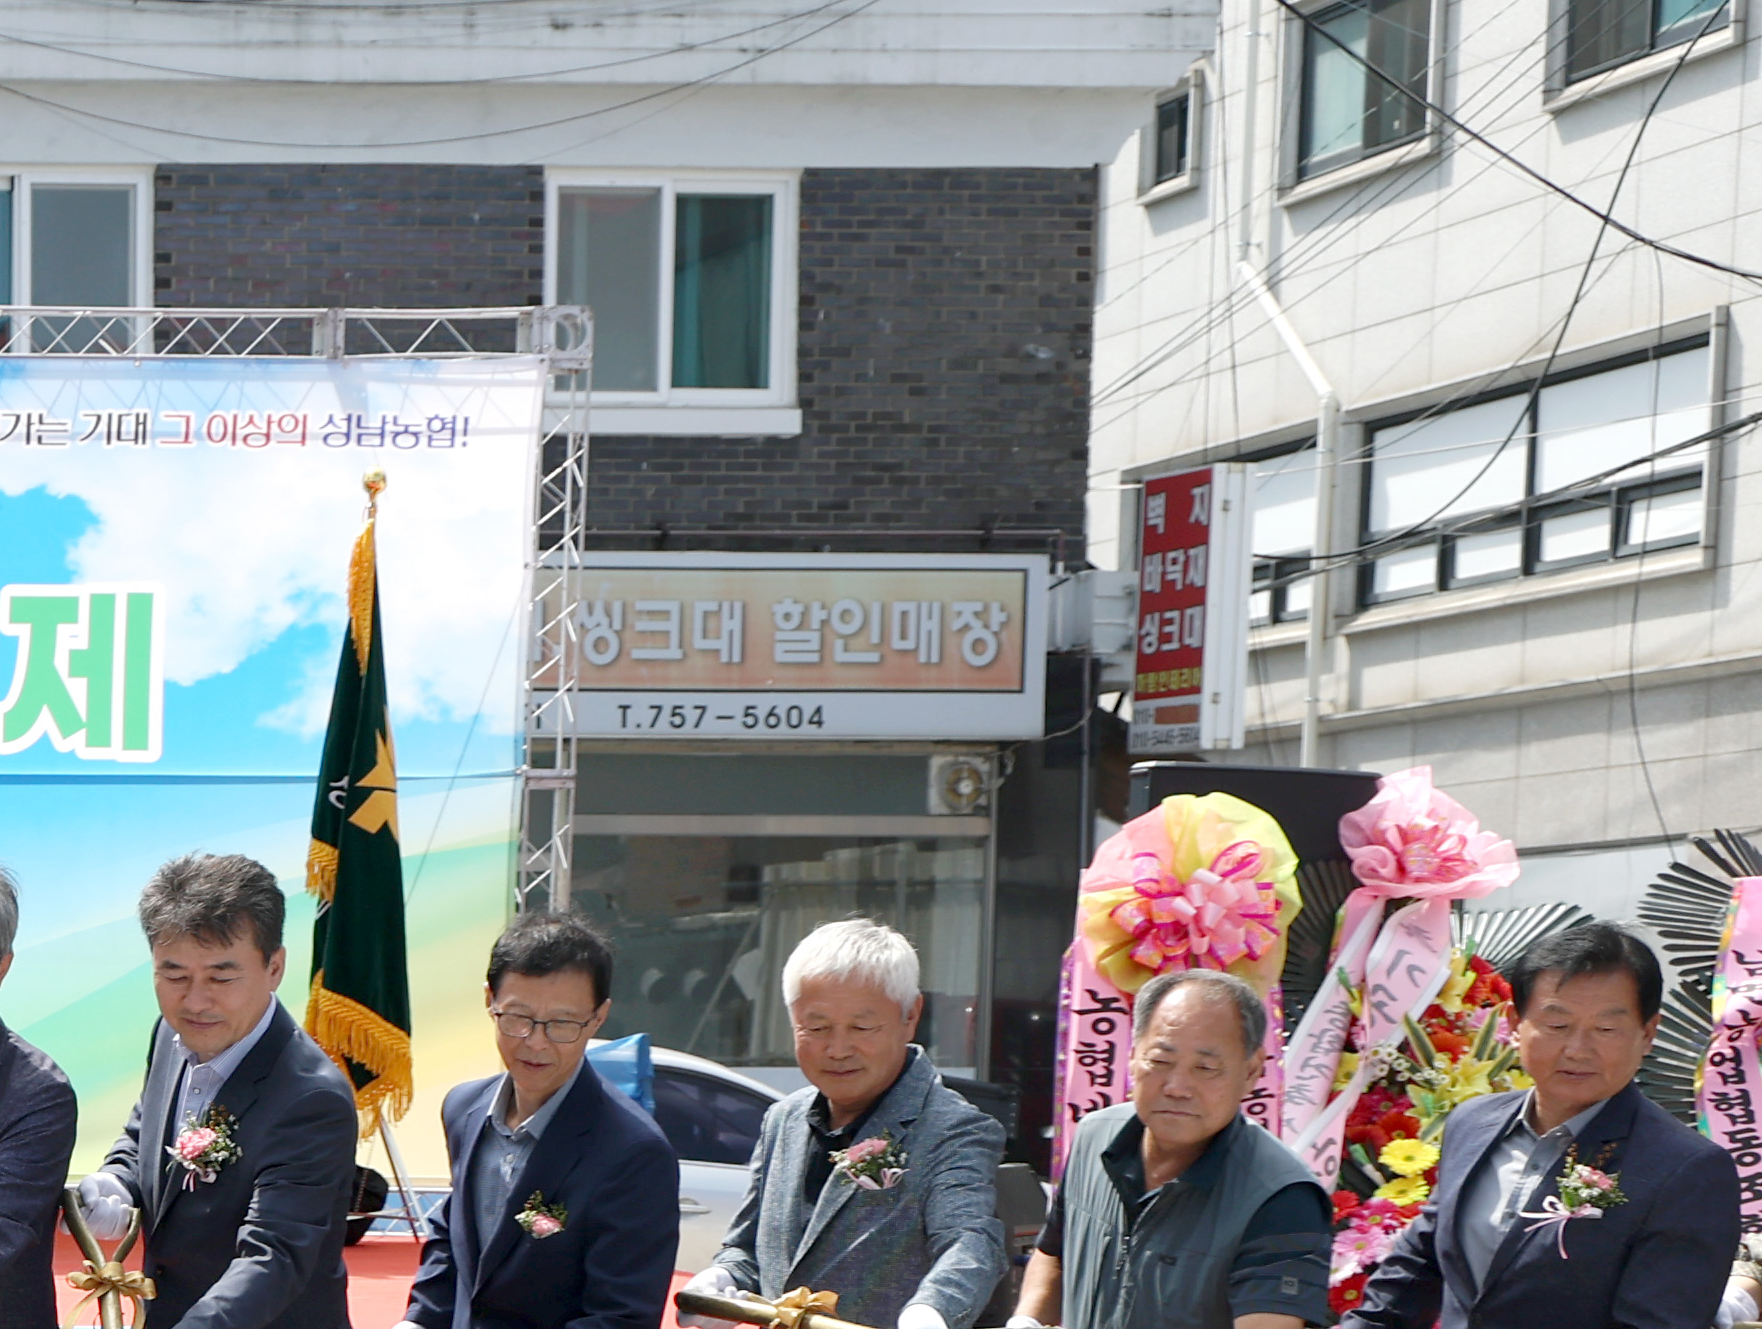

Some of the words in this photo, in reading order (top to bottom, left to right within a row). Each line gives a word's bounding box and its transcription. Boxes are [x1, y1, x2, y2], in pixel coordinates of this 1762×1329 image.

[79, 408, 148, 447] 기대
[160, 411, 194, 446] 그
[206, 410, 308, 448] 이상의
[320, 411, 469, 450] 성남농협!
[1142, 544, 1207, 593] 바닥재
[772, 597, 1010, 668] 할인매장
[1139, 604, 1204, 655] 싱크대
[618, 704, 825, 731] T.757-5604
